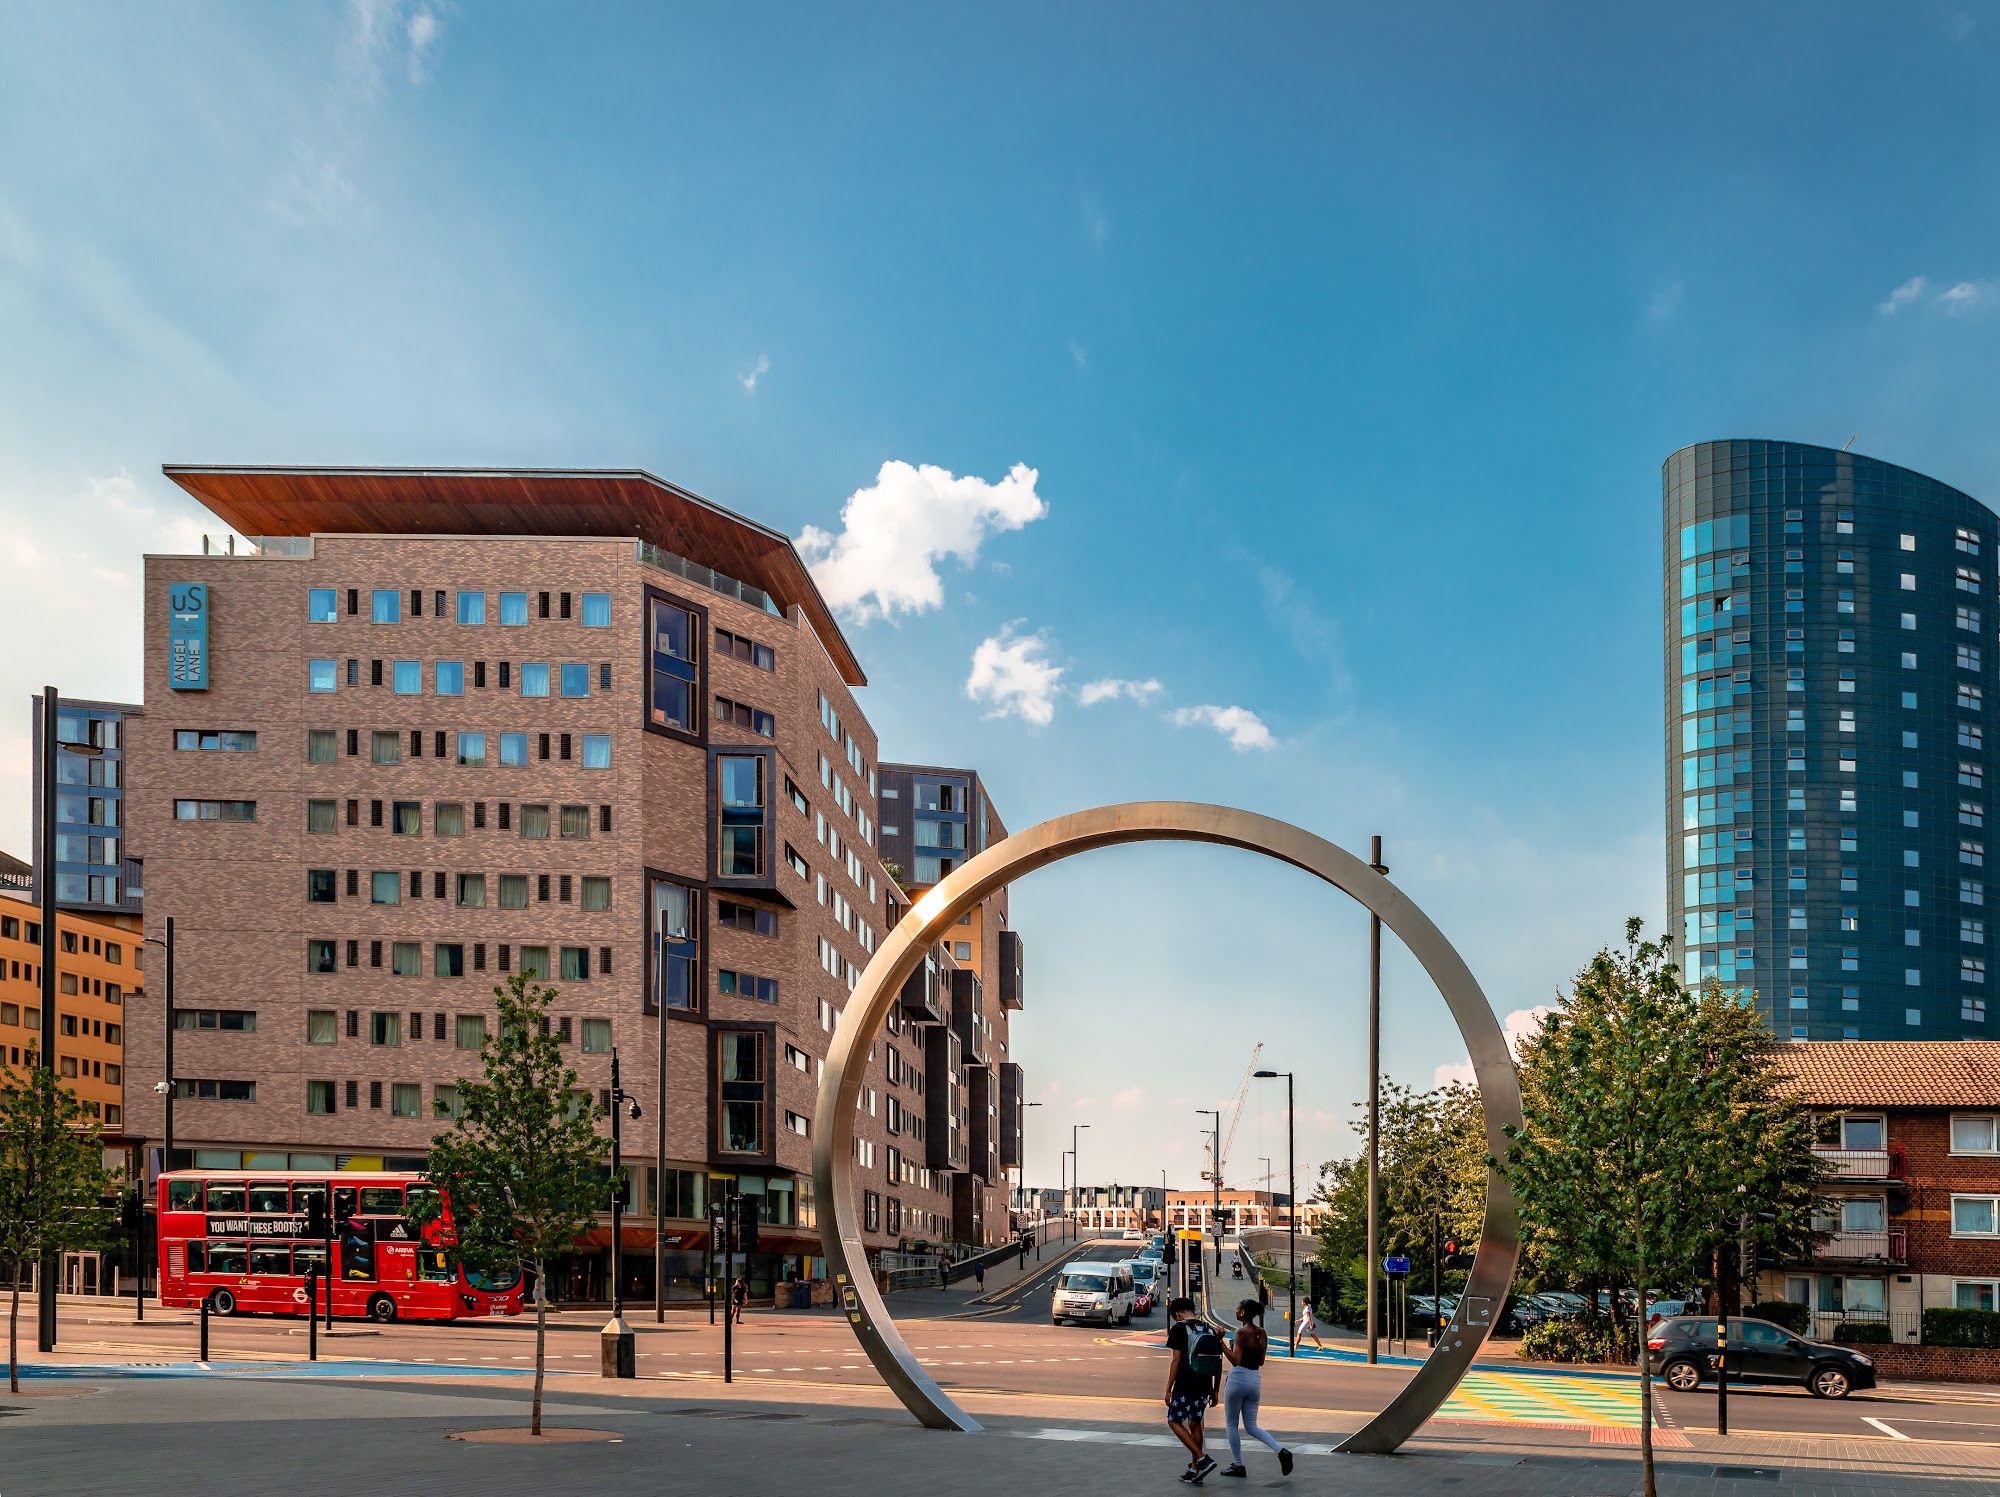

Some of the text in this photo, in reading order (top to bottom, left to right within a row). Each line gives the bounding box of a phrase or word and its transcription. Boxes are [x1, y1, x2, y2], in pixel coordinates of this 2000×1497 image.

[174, 640, 186, 682] ANGEL
[188, 649, 200, 682] LANE
[210, 1220, 303, 1234] YOU WANT THESE BOOTS?
